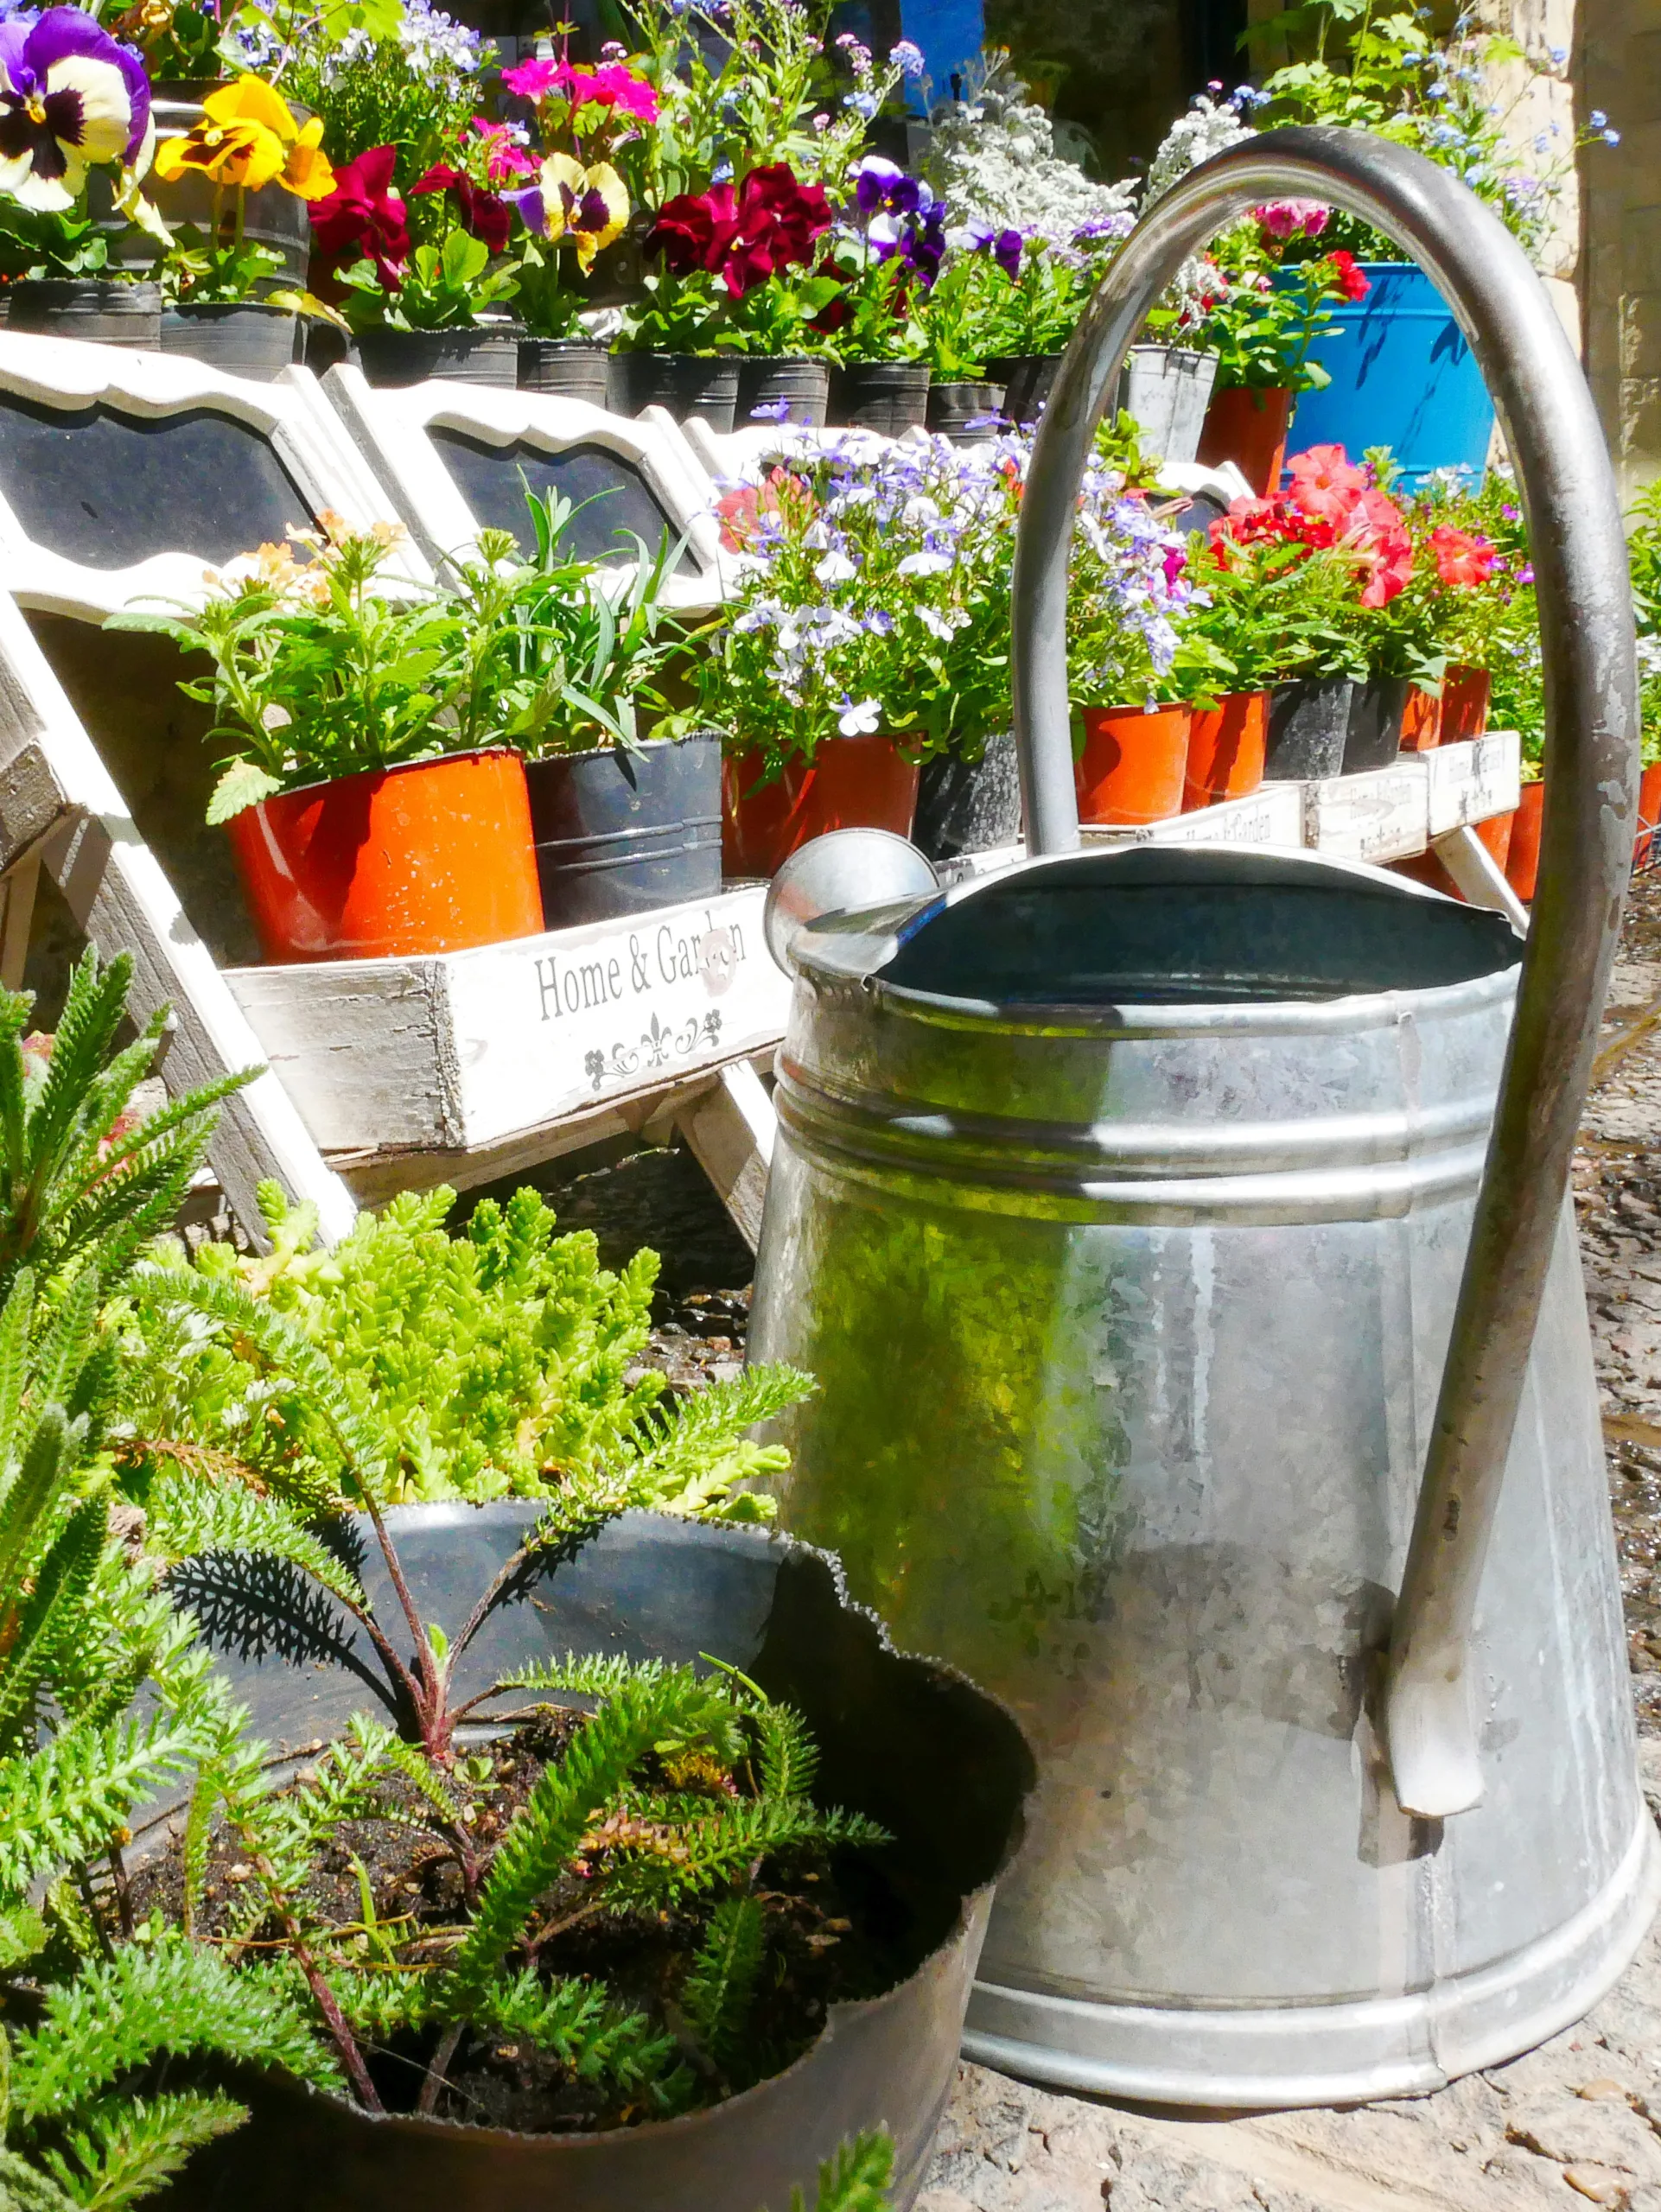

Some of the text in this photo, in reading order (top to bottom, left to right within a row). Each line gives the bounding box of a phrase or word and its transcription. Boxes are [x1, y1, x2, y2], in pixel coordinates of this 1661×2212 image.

[535, 910, 747, 1021] Home & Garn
